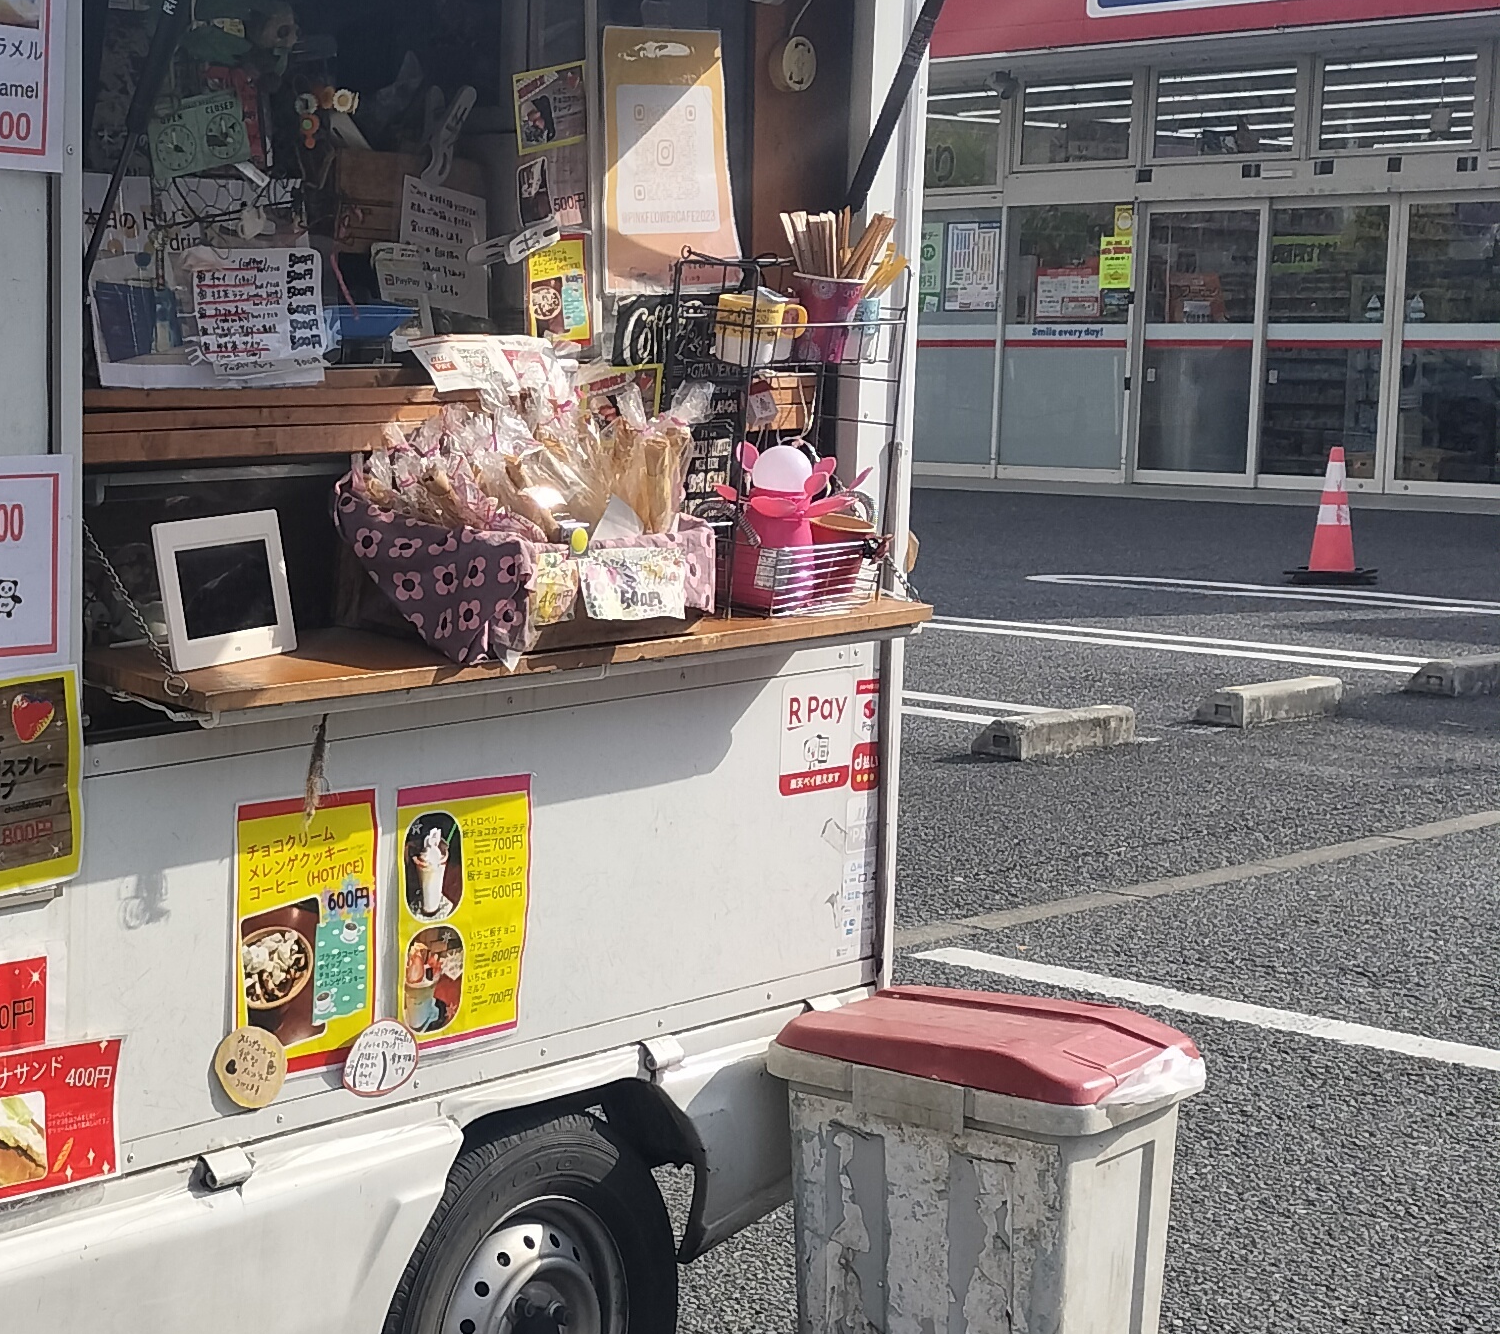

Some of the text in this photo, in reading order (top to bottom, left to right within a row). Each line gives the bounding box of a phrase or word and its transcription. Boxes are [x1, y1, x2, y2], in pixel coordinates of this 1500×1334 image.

[205, 100, 234, 114] CLOSED
[553, 192, 586, 212] 500円
[808, 696, 848, 724] Pay
[2, 818, 53, 846] 800円
[491, 834, 523, 851] 700円
[246, 826, 336, 862] チョコクリーム
[249, 846, 348, 882] メレンゲクッキー
[249, 879, 299, 902] コーヒー
[328, 887, 370, 911] 600円
[492, 882, 522, 899] 600円
[491, 945, 520, 963] 800円
[488, 988, 514, 1005] 700円
[65, 1066, 112, 1089] 400円
